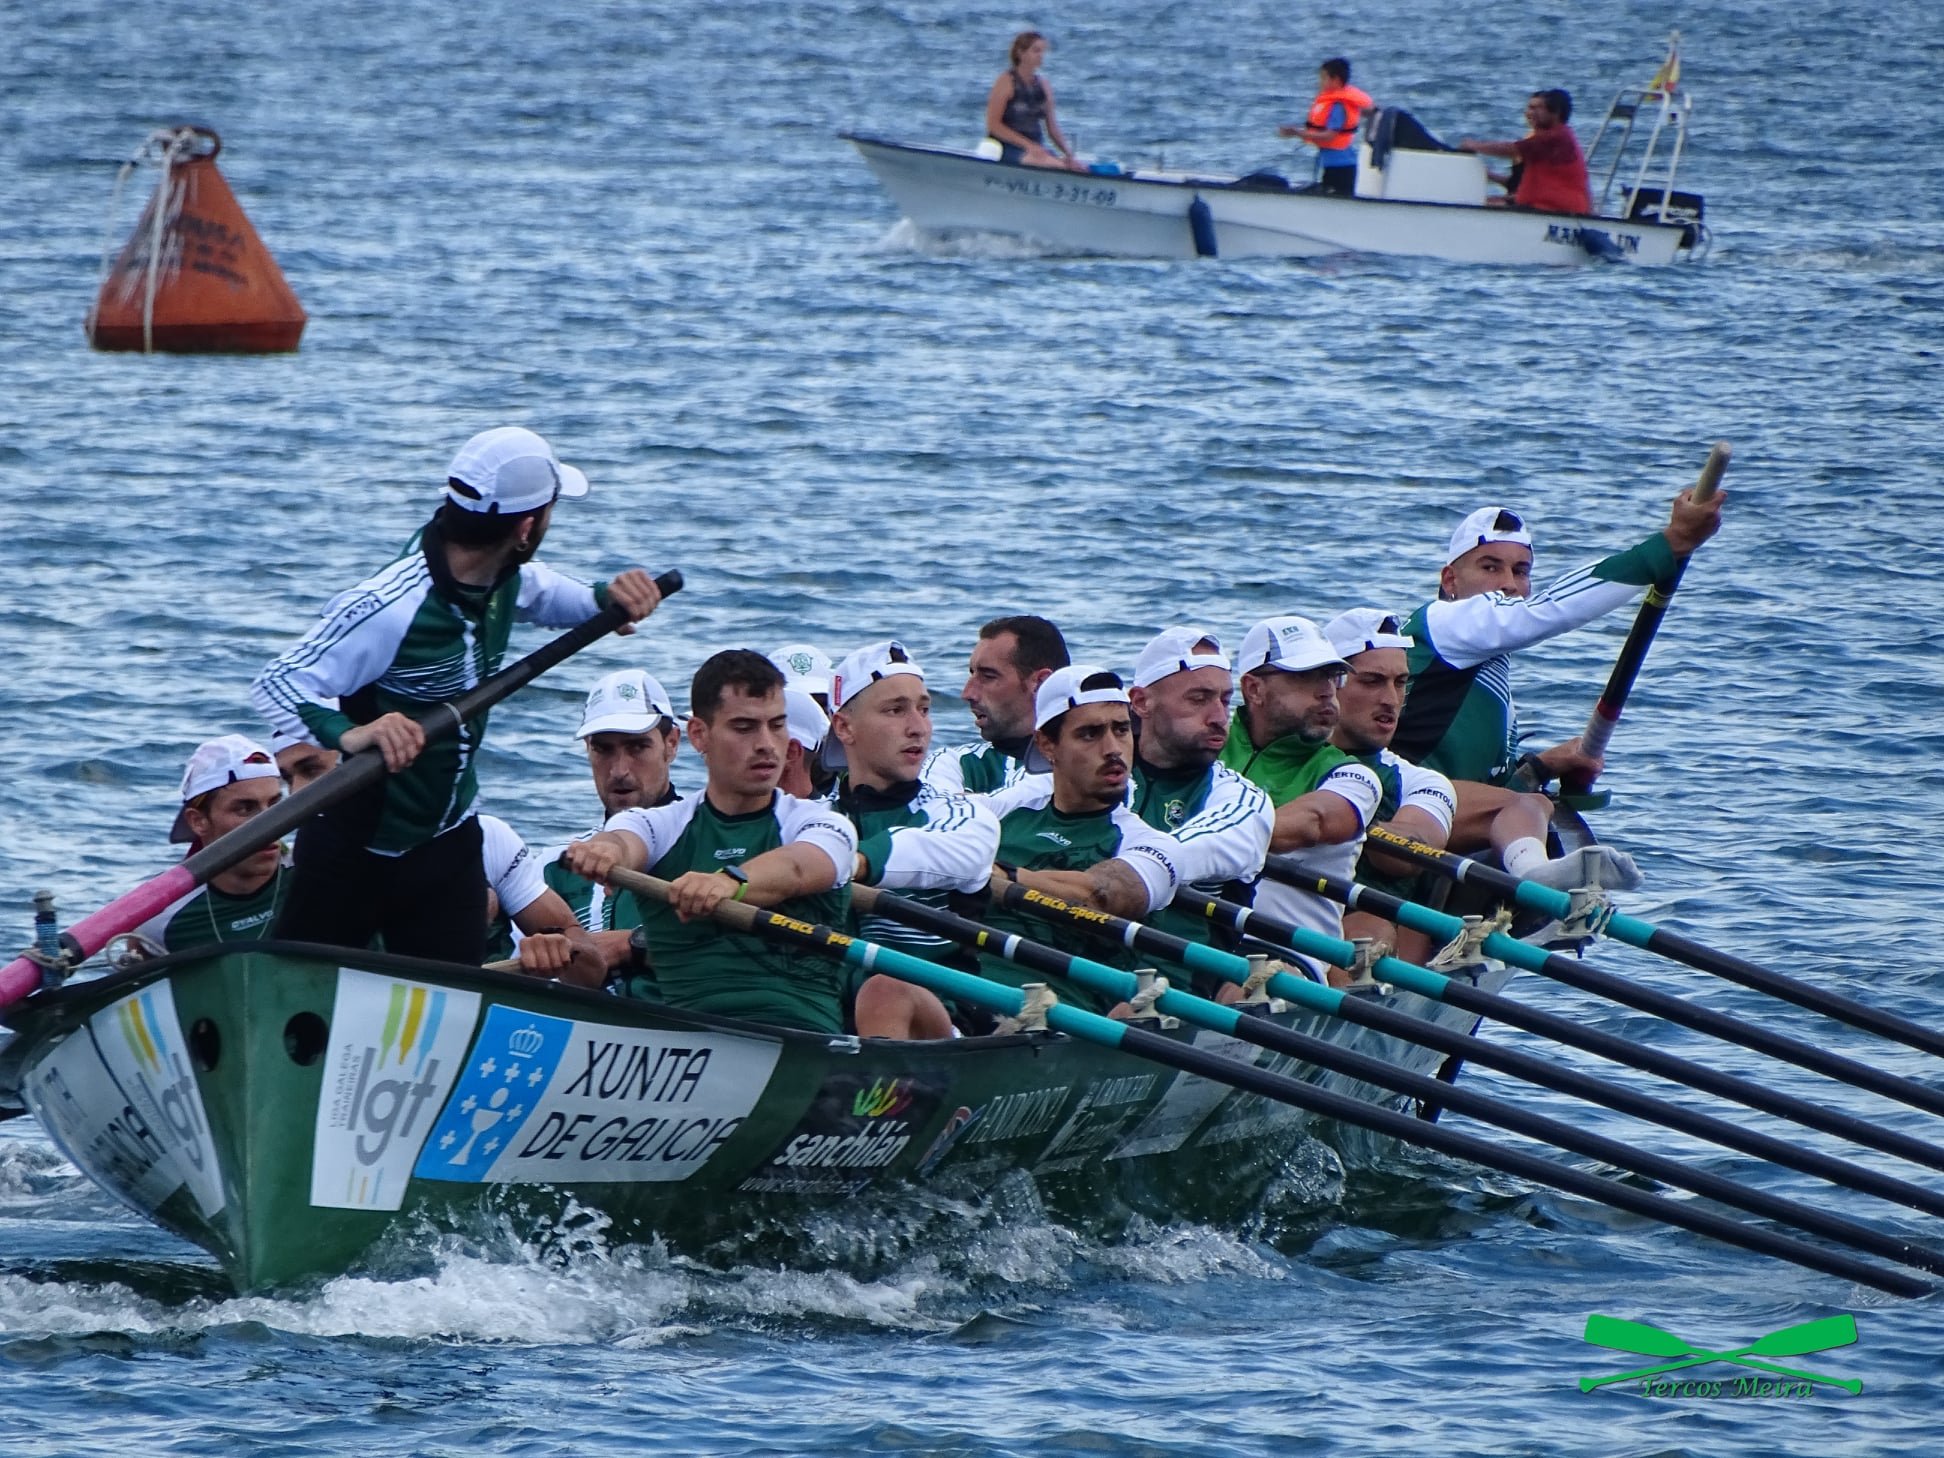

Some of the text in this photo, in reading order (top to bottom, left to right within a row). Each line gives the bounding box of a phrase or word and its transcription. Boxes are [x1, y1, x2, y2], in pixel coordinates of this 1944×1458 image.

[1368, 826, 1446, 858] Braca-sport
[1023, 889, 1110, 924] Braca-sport
[563, 1040, 713, 1102] XUNTA
[347, 1045, 440, 1167] lgt
[518, 1111, 748, 1161] DE GALICIA
